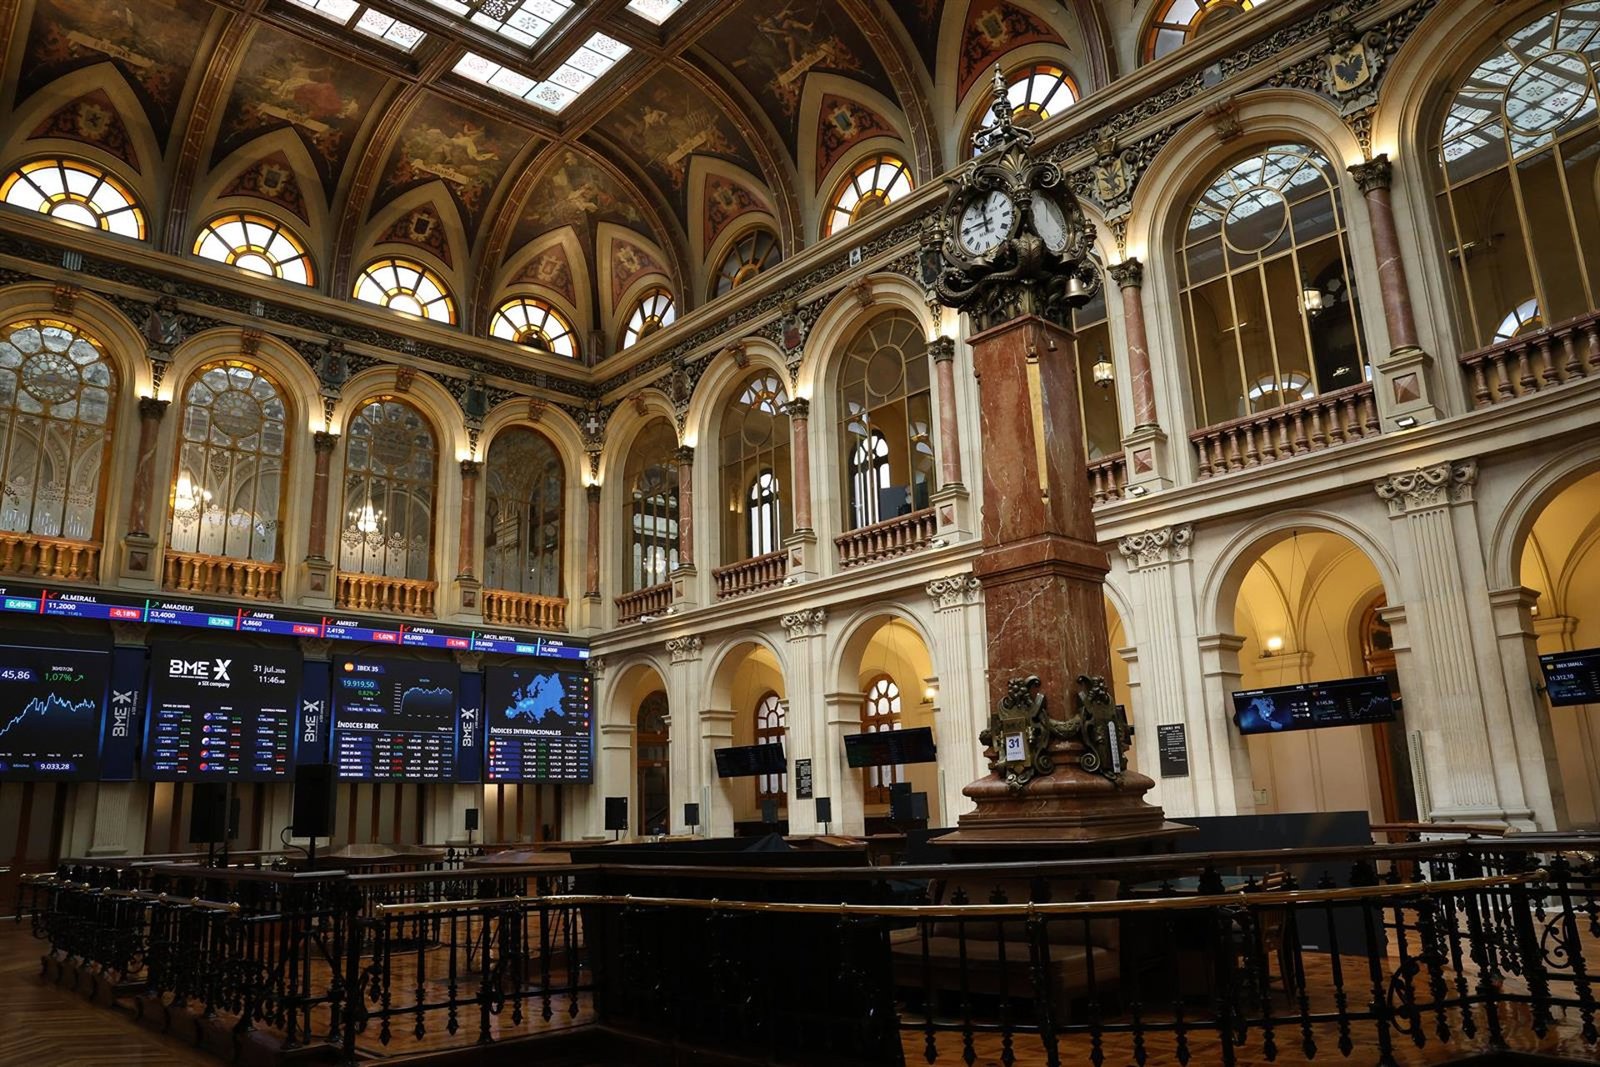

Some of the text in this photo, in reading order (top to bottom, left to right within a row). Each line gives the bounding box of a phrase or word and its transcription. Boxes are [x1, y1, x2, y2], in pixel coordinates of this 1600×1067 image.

[61, 594, 96, 602] ALMIRALL
[169, 659, 209, 675] BME
[2, 671, 30, 680] 45,86
[45, 673, 72, 681] 1,07%
[112, 707, 127, 736] BME
[304, 715, 316, 742] BME
[462, 722, 472, 746] BME
[1008, 738, 1020, 749] 31
